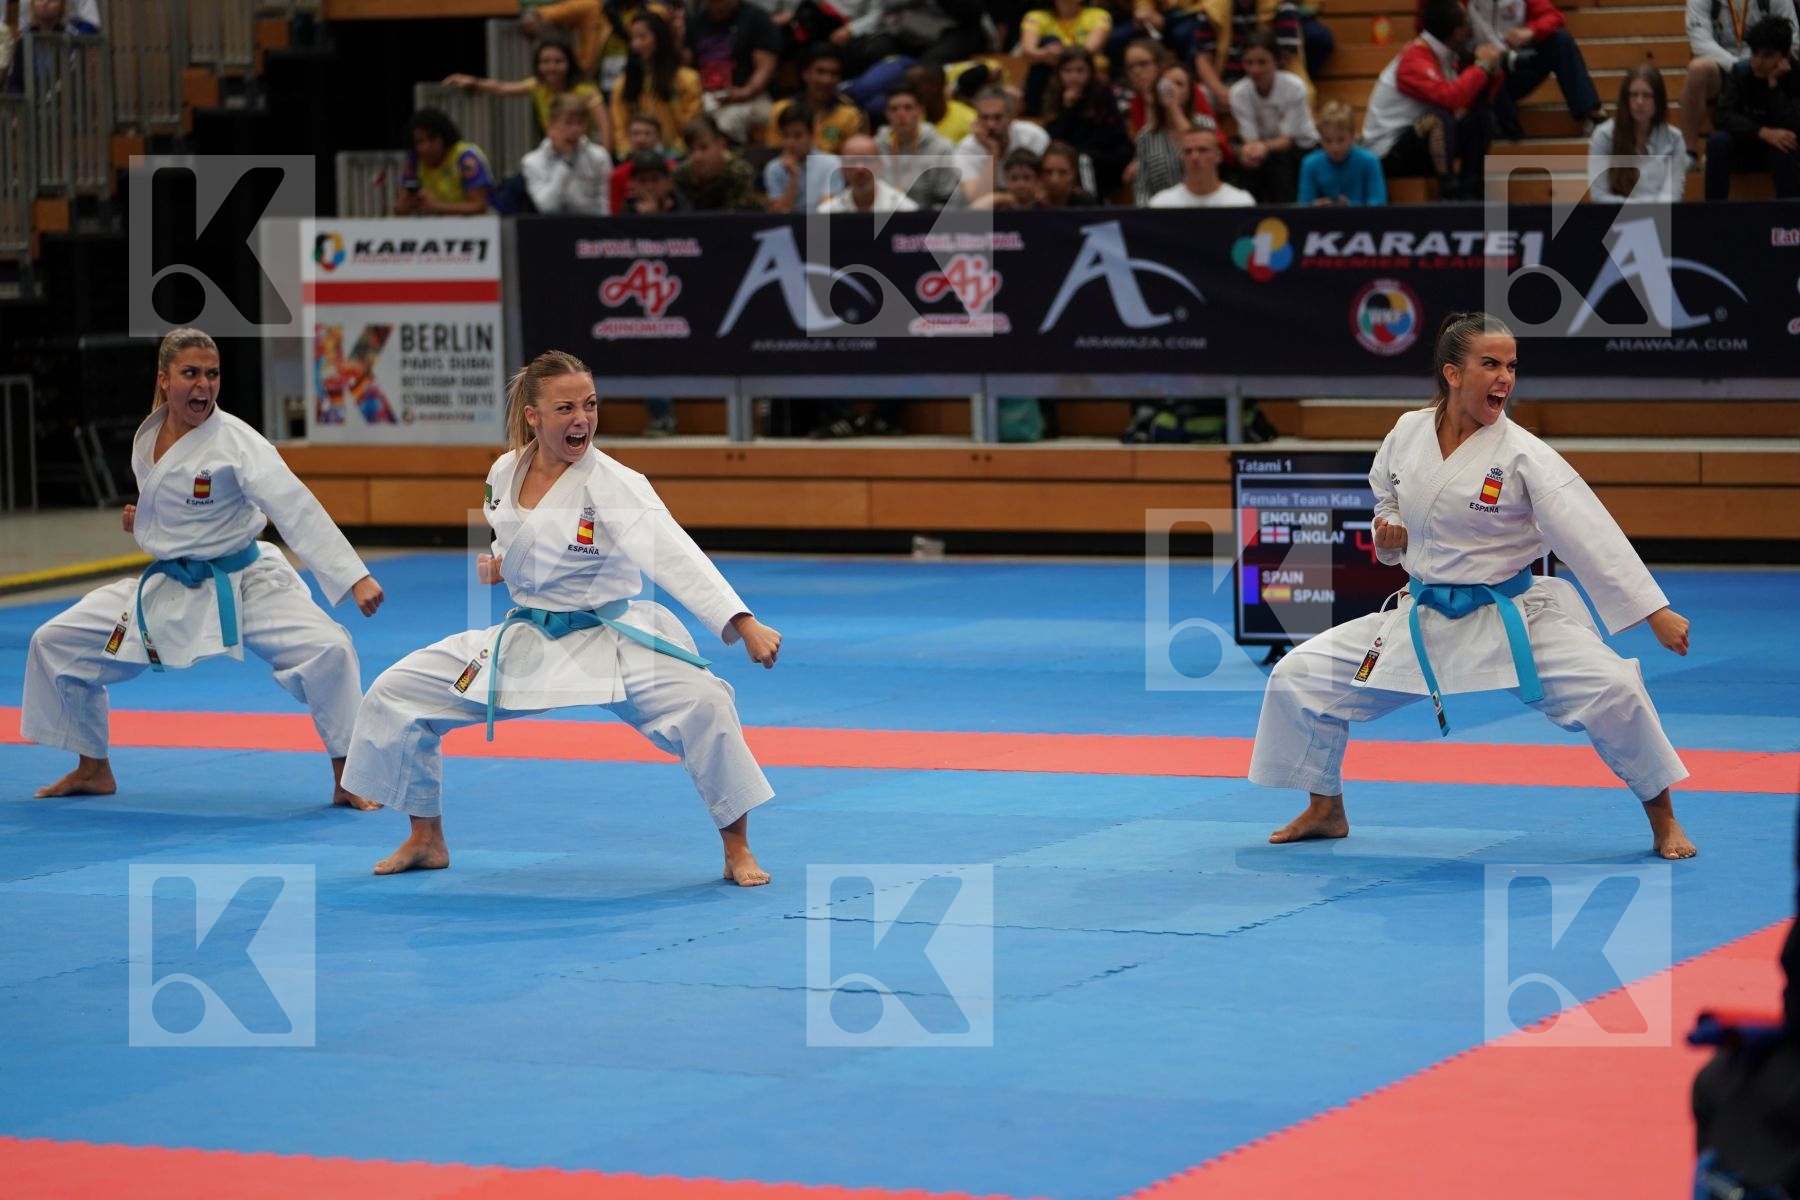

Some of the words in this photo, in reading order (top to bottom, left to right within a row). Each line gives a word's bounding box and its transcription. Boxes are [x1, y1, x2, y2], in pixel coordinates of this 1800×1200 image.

[354, 238, 489, 263] KARATE1
[1303, 231, 1544, 267] KARATE1
[1301, 257, 1410, 269] PREMIER
[401, 323, 494, 353] BERLIN
[1075, 336, 1207, 349] ARAWAZA.COM
[1605, 337, 1748, 351] ARAWAZA.COM
[1237, 459, 1281, 473] Tatami
[1285, 459, 1292, 472] 1
[1241, 493, 1288, 506] Female
[1292, 493, 1327, 506] Team
[1331, 493, 1361, 506] Kata
[1260, 511, 1328, 526] ENGLAND
[1262, 571, 1303, 584] SPAIN
[1293, 589, 1335, 602] SPAIN
